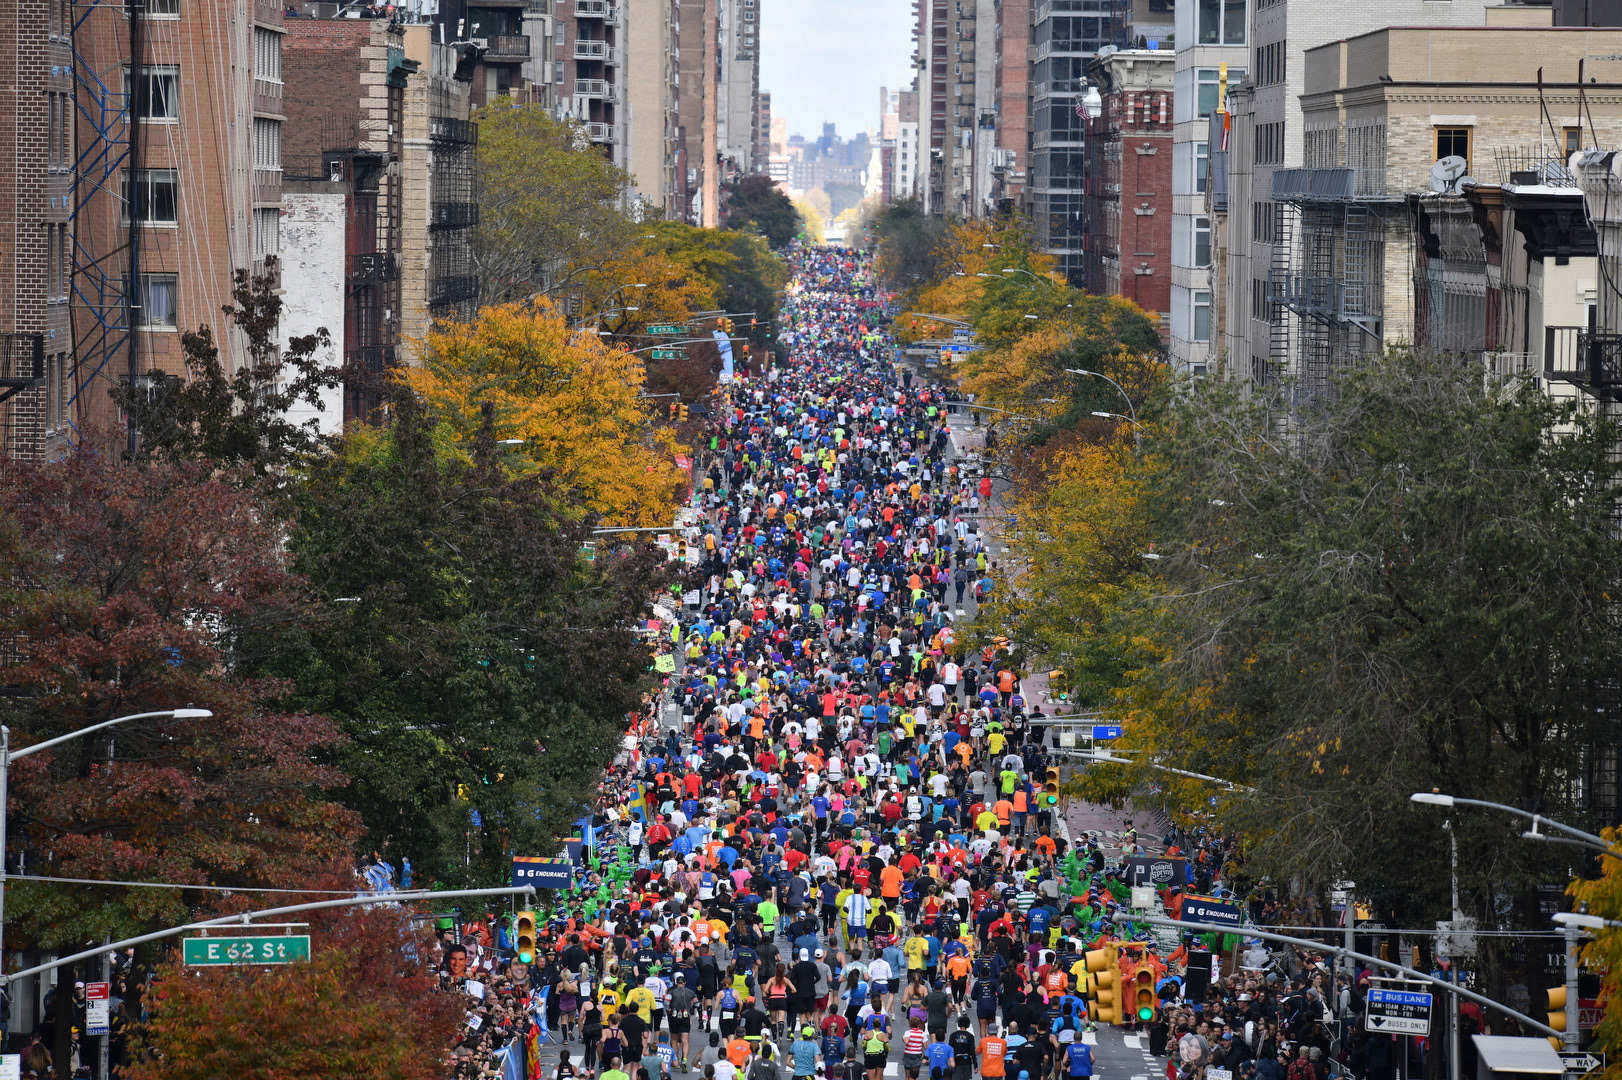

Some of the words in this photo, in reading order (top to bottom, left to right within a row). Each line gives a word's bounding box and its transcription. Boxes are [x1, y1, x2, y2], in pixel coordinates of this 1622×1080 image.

[1151, 870, 1173, 878] Spring
[1206, 910, 1239, 920] ENDURANCE
[208, 944, 220, 959] E
[227, 943, 254, 959] 62
[263, 943, 285, 958] St
[1405, 995, 1426, 1003] LANE
[1578, 1009, 1604, 1022] ATM
